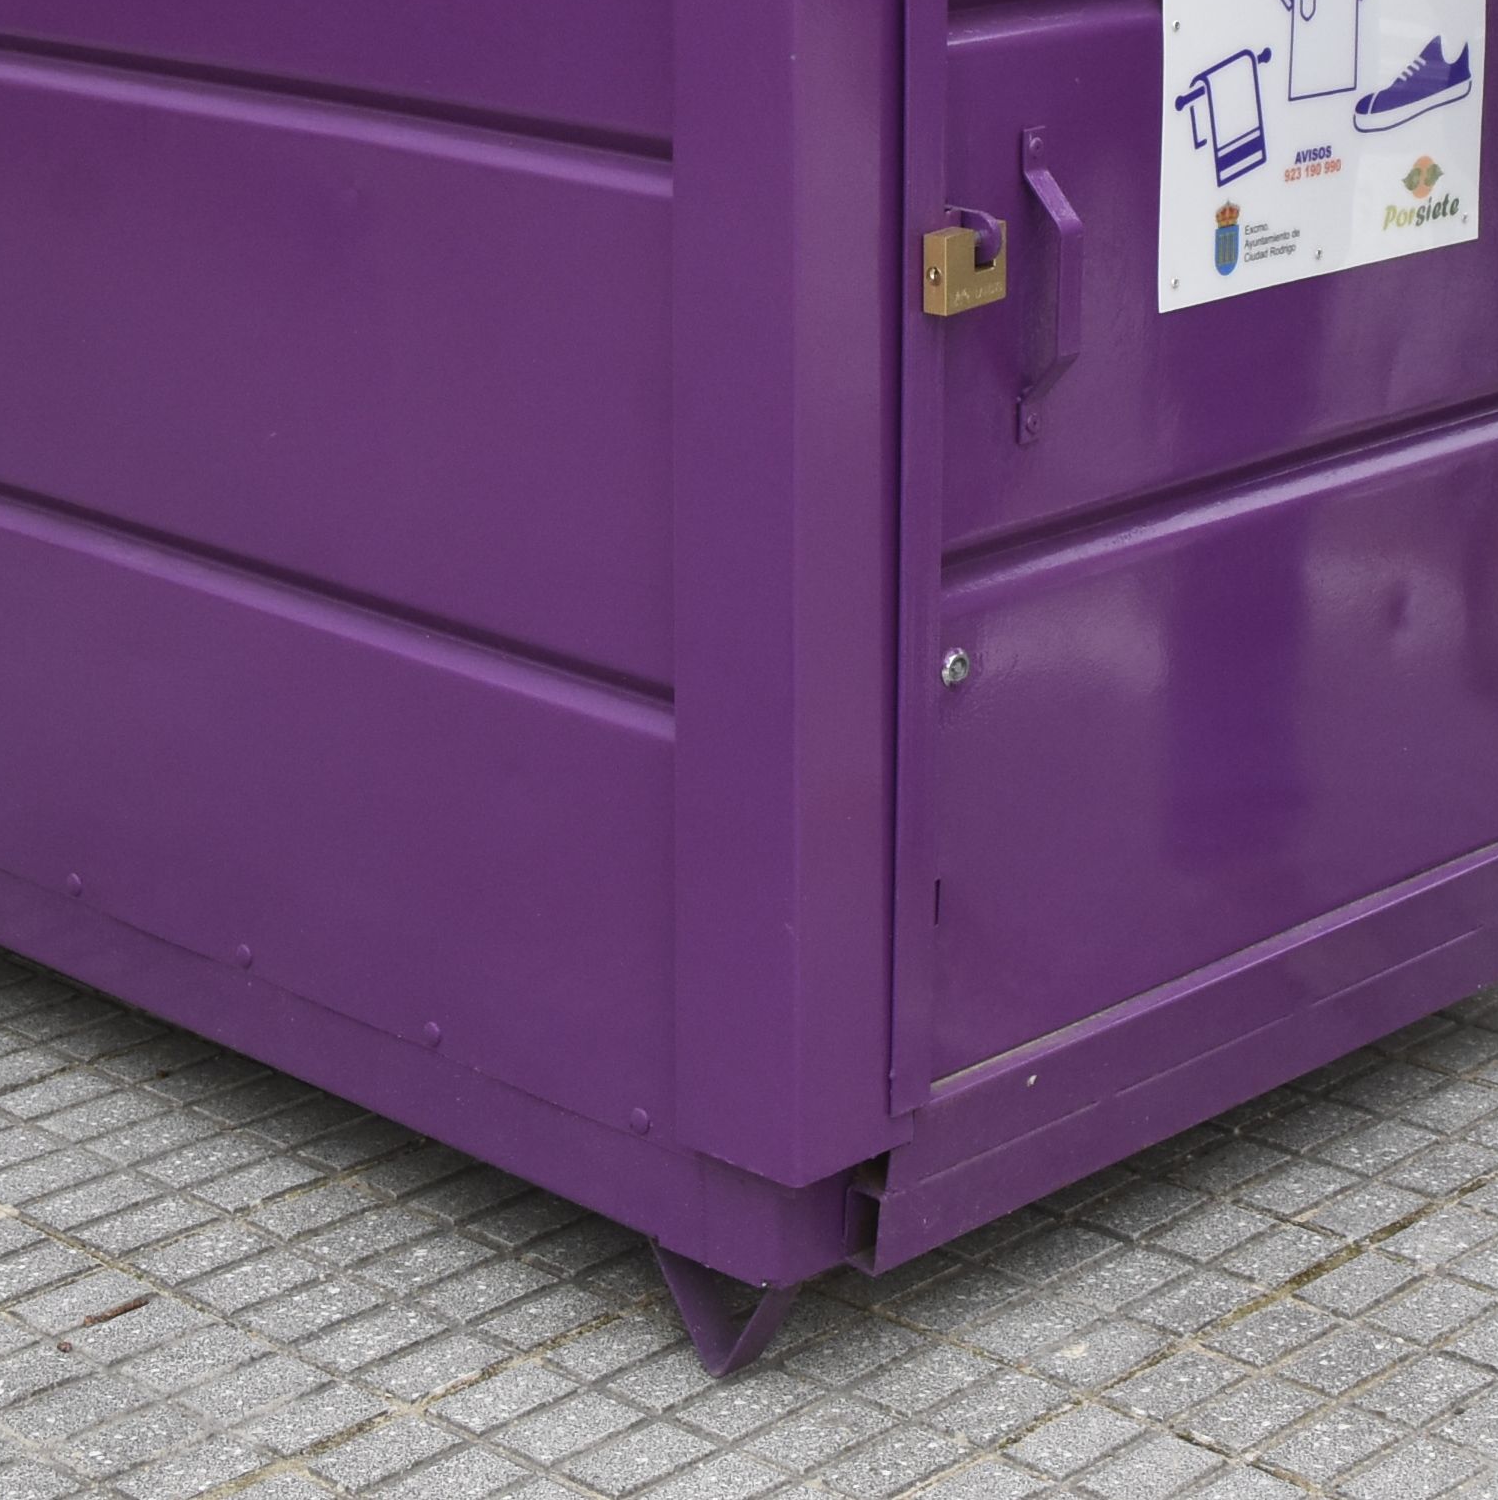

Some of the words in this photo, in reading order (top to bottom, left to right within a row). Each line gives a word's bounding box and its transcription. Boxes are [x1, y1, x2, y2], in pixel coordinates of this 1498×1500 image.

[1294, 145, 1333, 165] AVISOS
[1283, 166, 1302, 182] 923
[1304, 162, 1322, 178] 190
[1383, 193, 1460, 232] Porsiete
[1244, 231, 1290, 250] Ayuntamiento
[1291, 228, 1300, 238] de
[1244, 247, 1268, 263] Ciudad
[1269, 243, 1297, 259] Rodrigo
